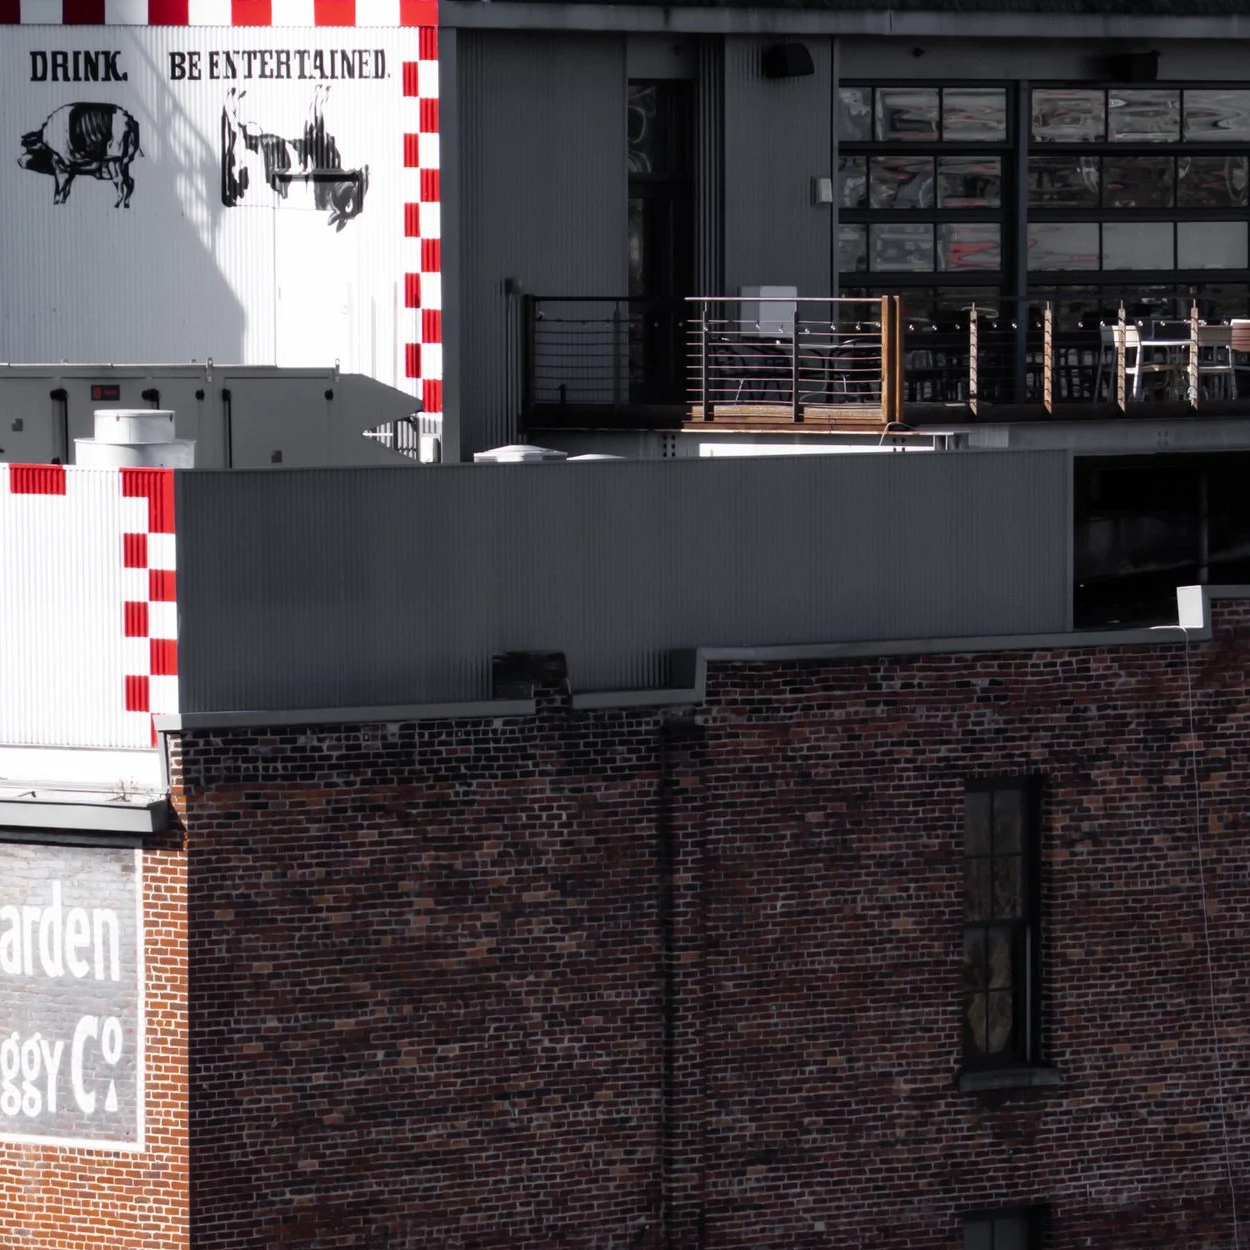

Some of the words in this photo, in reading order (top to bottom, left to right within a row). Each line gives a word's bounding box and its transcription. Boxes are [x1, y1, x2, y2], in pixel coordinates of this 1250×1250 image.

[29, 49, 128, 82] DRINK.
[169, 50, 203, 81] BE
[208, 48, 390, 80] ENTERTAINED.
